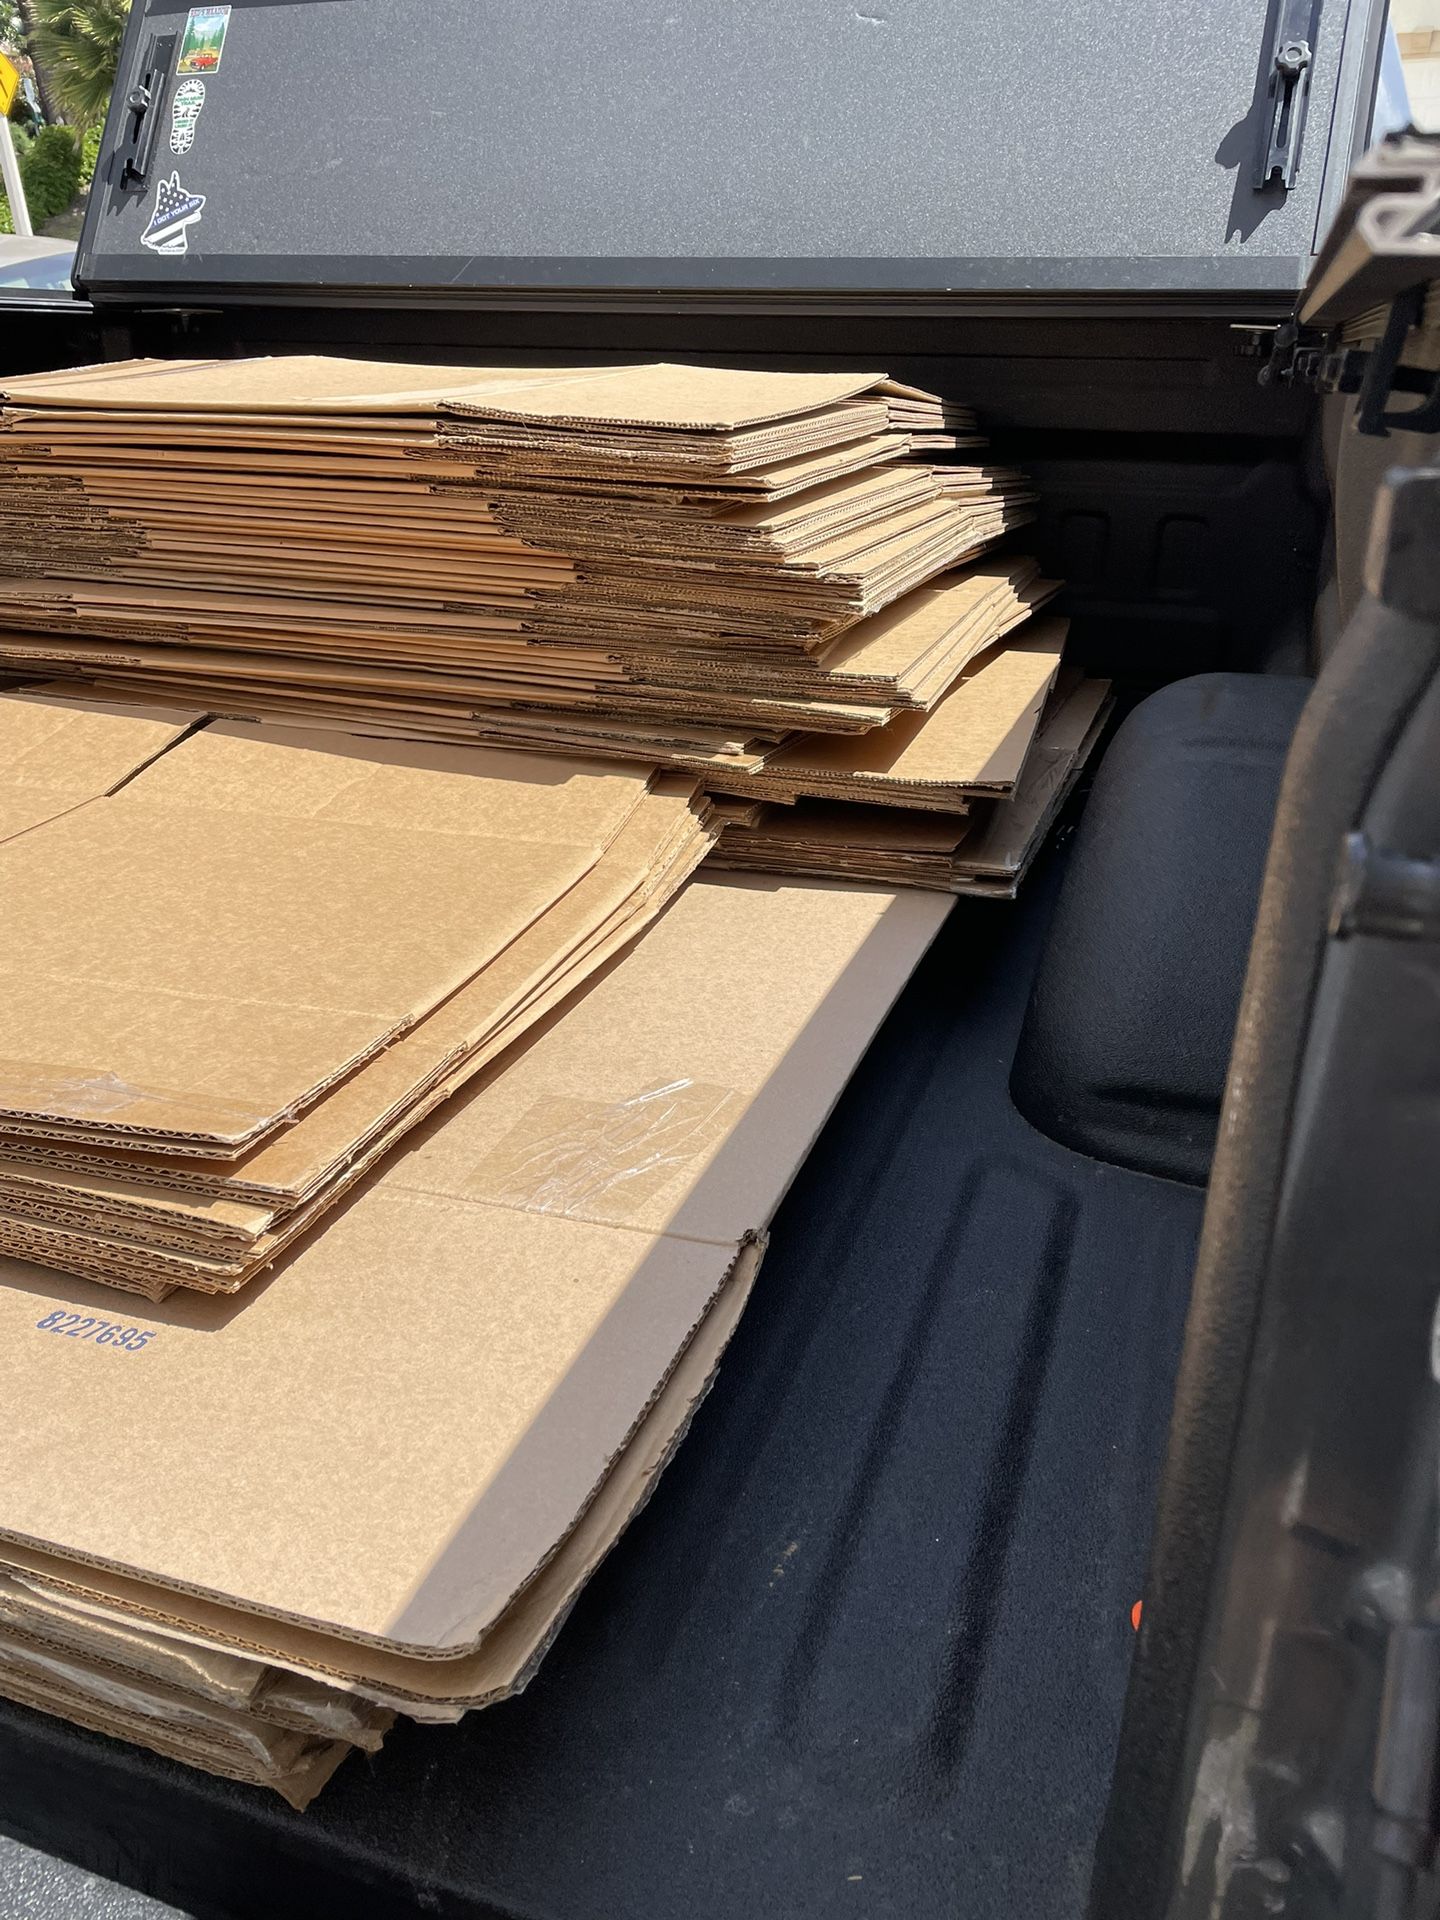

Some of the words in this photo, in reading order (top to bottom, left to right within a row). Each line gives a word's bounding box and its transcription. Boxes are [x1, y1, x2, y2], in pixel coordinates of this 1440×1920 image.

[157, 213, 170, 224] GOT
[171, 204, 188, 216] YOUR
[37, 1311, 157, 1351] 8227695
